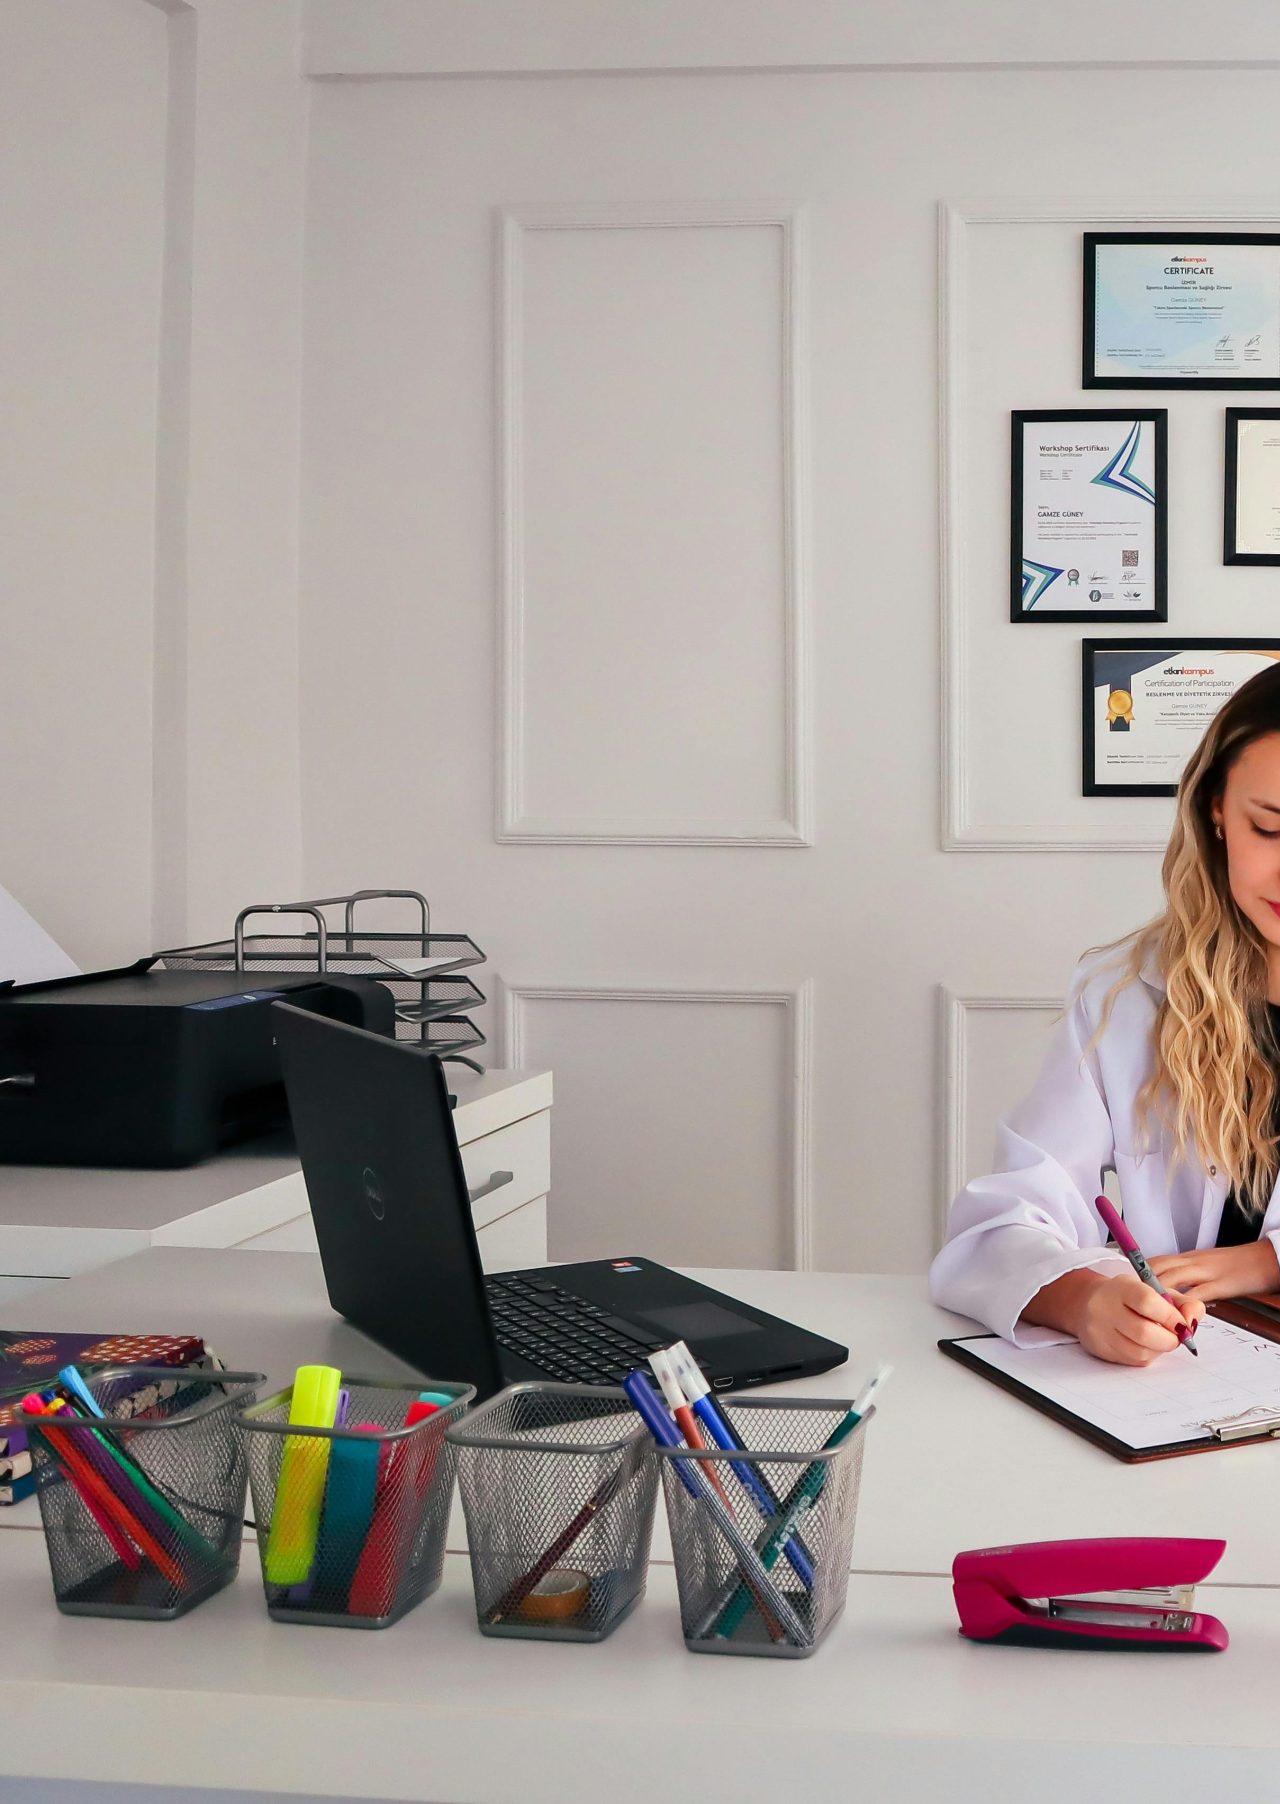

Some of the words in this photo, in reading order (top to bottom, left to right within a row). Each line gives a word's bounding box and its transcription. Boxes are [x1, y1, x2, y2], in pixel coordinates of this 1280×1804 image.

[1164, 267, 1214, 275] CERTIFICATE
[1040, 445, 1073, 453] Workshop
[1193, 680, 1234, 688] Participation
